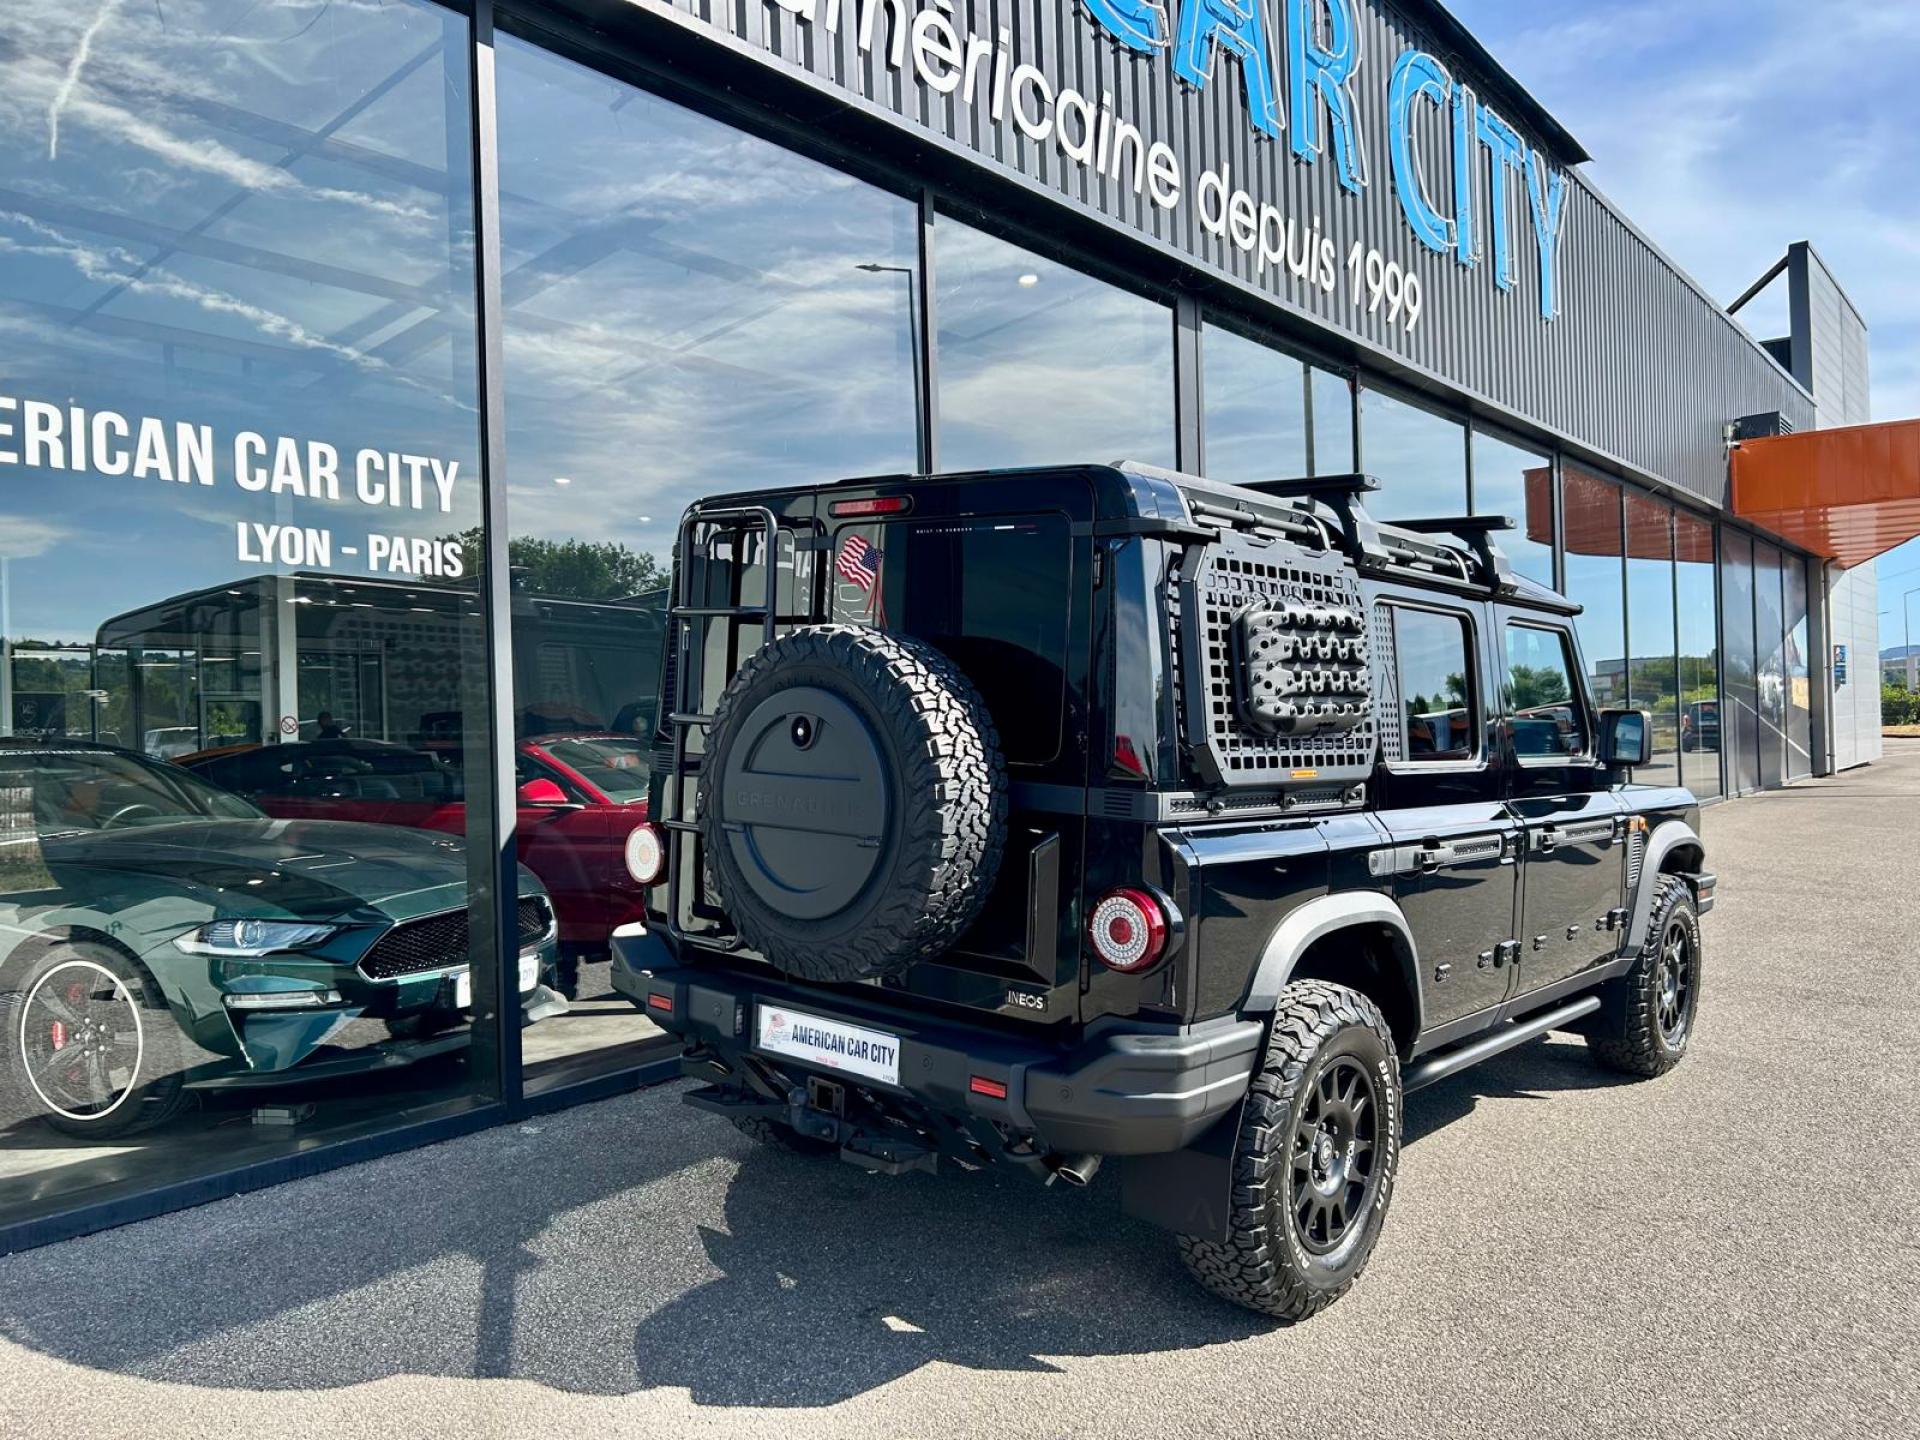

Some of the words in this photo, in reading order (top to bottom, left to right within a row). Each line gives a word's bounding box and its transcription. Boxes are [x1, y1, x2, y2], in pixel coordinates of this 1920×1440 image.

[774, 0, 1180, 209] méricaine
[1198, 162, 1336, 292] depuis
[1348, 240, 1422, 333] 1999
[1080, 0, 1368, 196] AR
[1389, 50, 1570, 322] CITY
[234, 431, 340, 500] CAR
[356, 448, 460, 513] CITY
[237, 522, 331, 568] LYON
[368, 534, 463, 577] PARIS
[1008, 990, 1044, 1009] INEOS
[791, 1024, 847, 1055] AMERICAN
[847, 1037, 869, 1061] CAR
[870, 1043, 895, 1067] CITY
